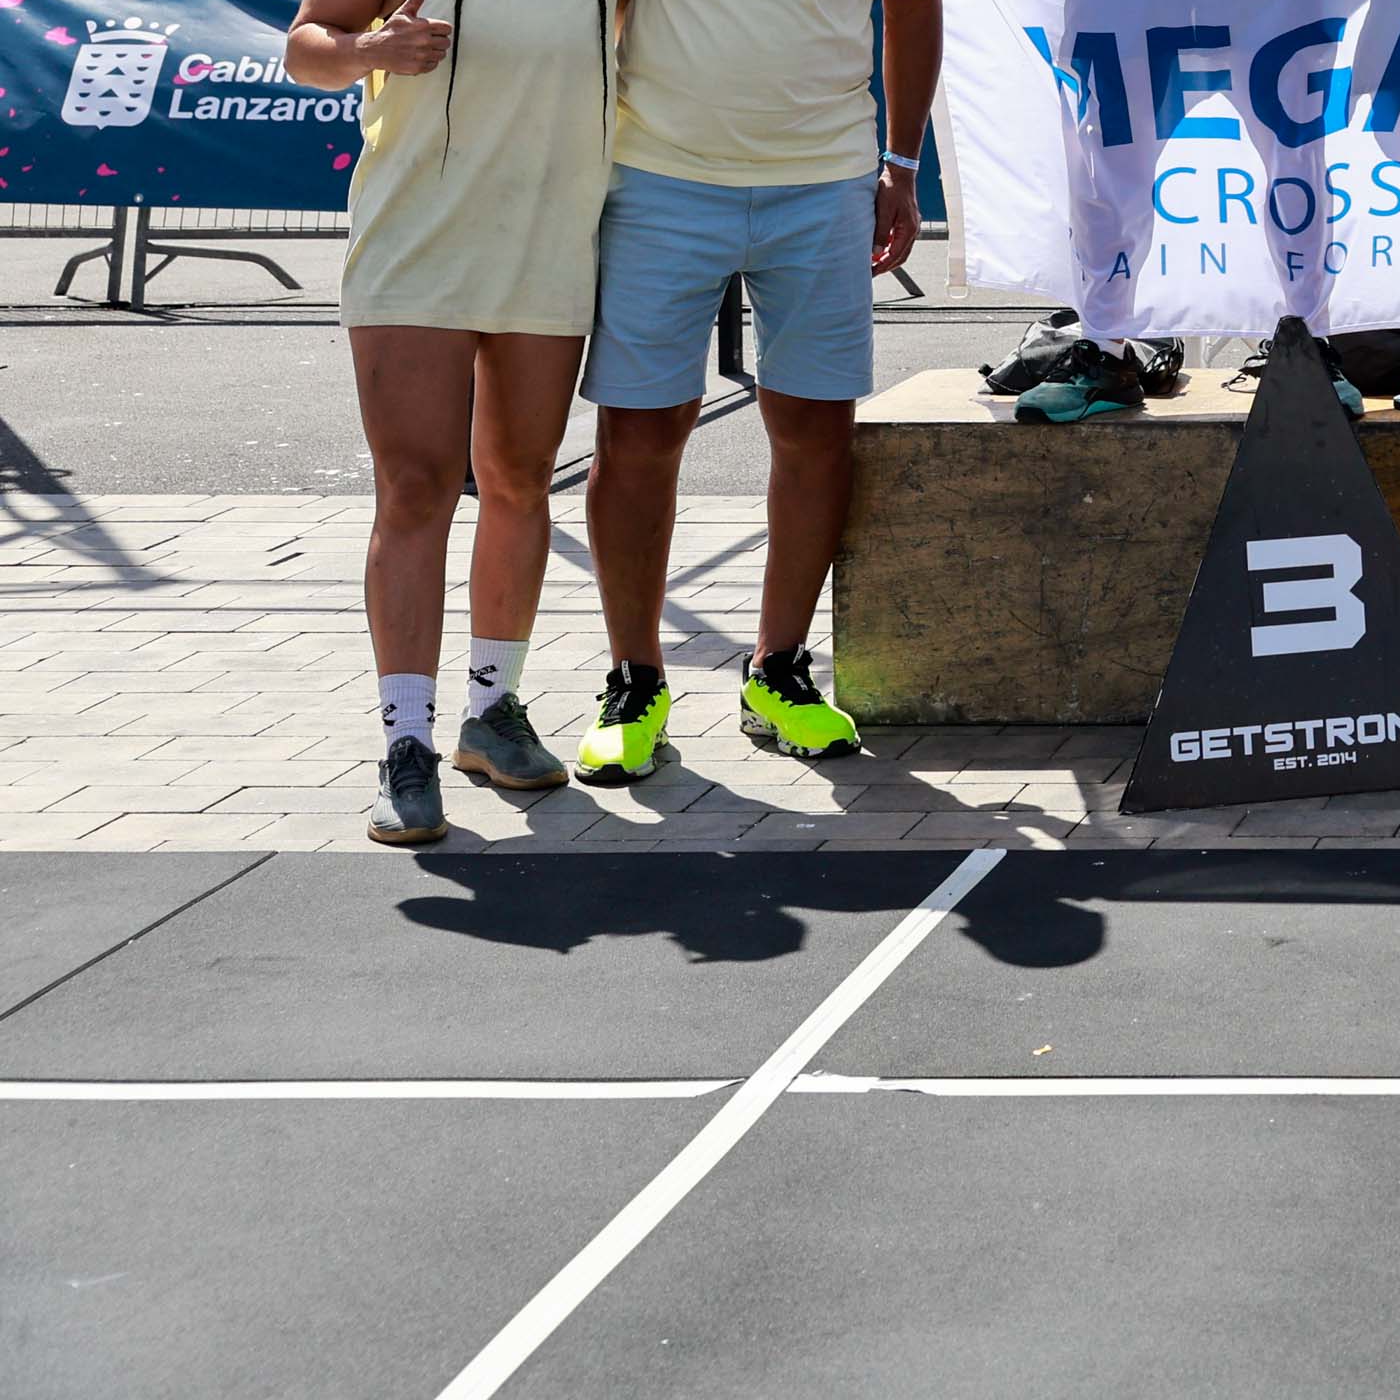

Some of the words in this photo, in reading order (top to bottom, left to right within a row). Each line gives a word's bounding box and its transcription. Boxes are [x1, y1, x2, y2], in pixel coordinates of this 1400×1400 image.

[178, 53, 296, 84] Cabil
[1288, 234, 1393, 282] FOR
[1246, 534, 1366, 657] 3
[1273, 755, 1313, 770] EST.
[1317, 751, 1357, 767] 2014
